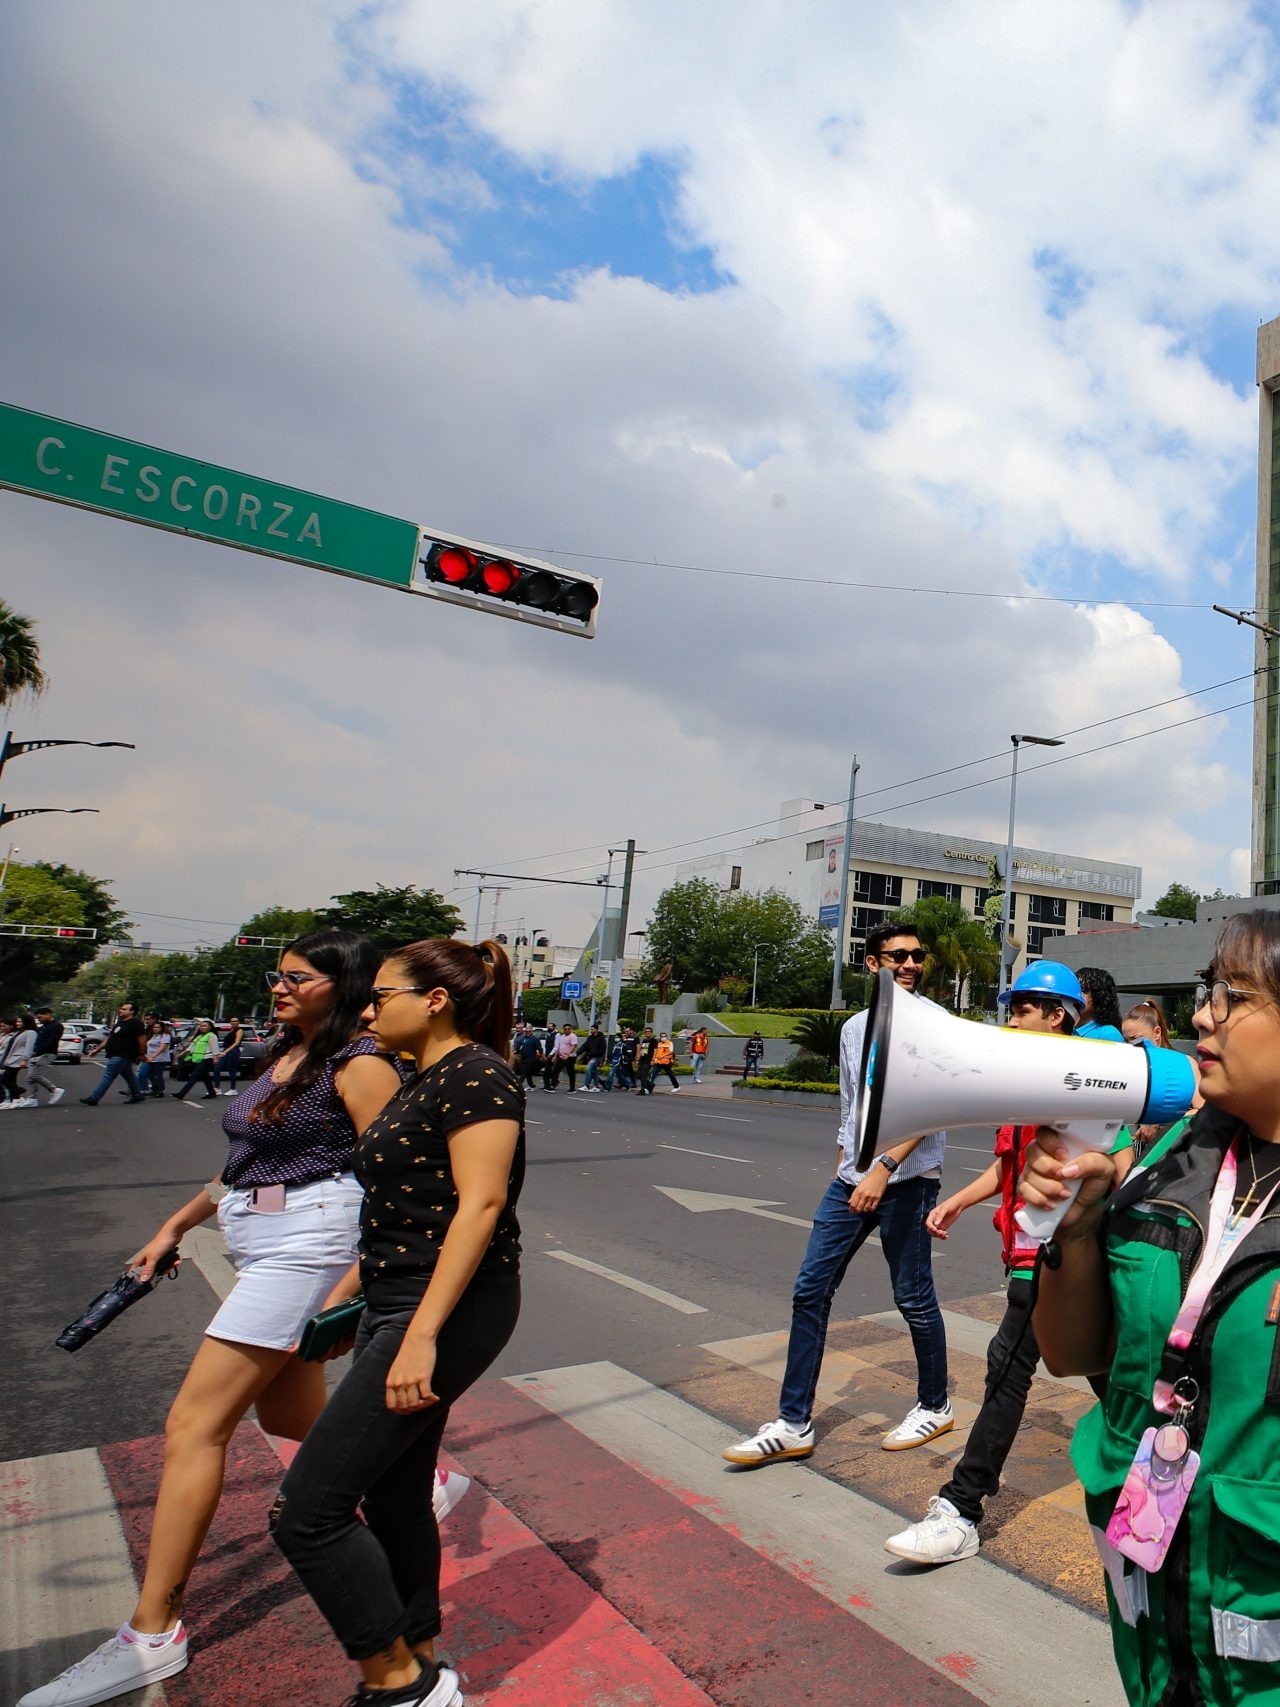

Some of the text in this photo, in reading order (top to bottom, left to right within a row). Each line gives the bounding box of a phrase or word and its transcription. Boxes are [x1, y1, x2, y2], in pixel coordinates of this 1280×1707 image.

[36, 436, 323, 547] C. ESCORZA
[1084, 1078, 1127, 1090] STEREN
